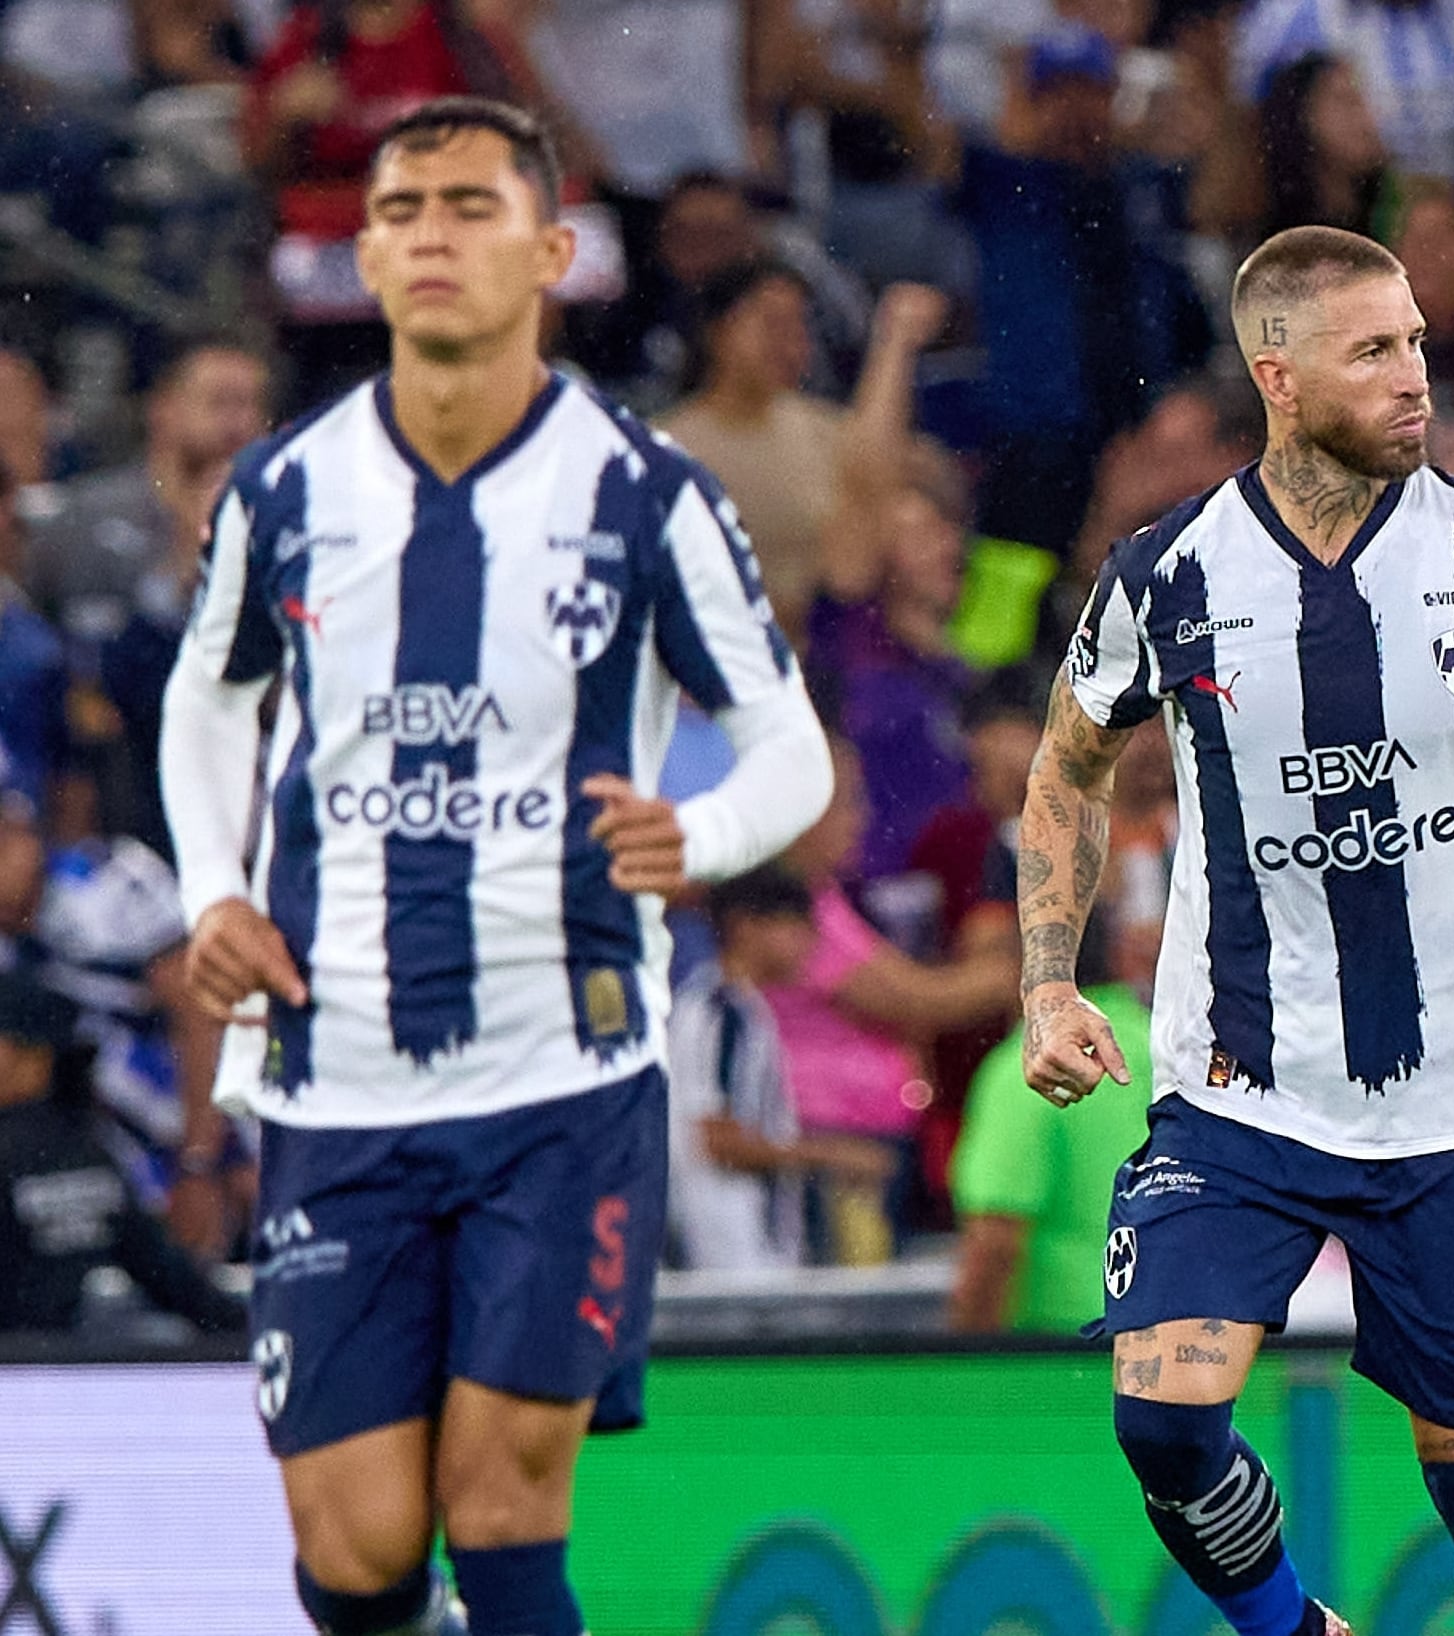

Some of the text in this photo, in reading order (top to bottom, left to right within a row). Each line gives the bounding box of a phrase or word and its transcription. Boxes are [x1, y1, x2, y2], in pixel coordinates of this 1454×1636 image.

[1261, 317, 1288, 348] 15
[362, 690, 510, 741] BBVA
[1279, 738, 1418, 794] BBVA
[327, 768, 551, 830] codere
